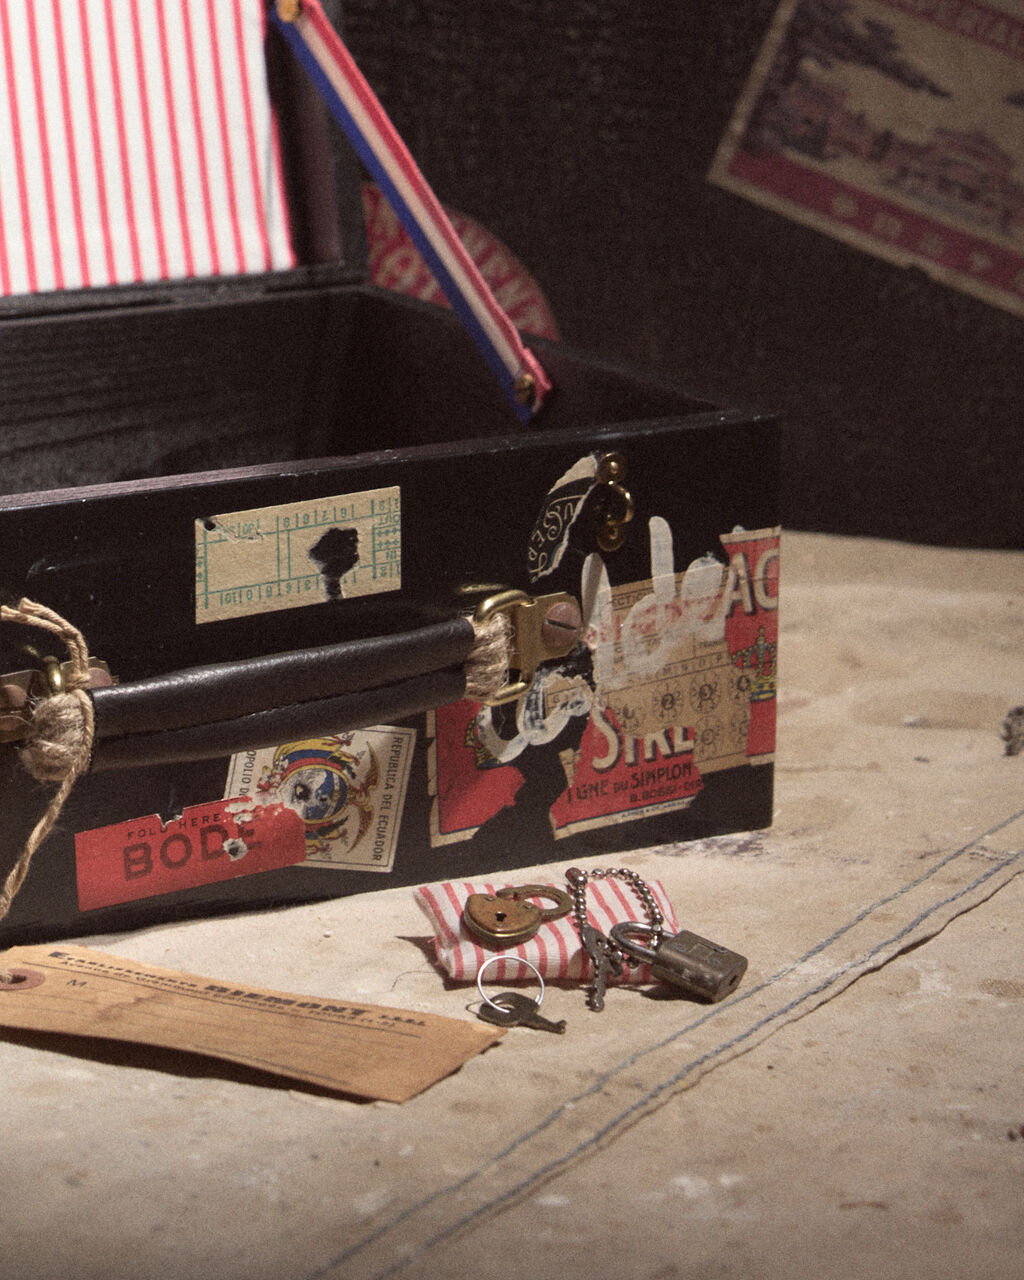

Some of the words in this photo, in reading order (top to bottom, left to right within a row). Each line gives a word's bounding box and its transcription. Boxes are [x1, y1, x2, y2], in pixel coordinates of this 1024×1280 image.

[384, 736, 404, 791] REPUBLICA
[631, 761, 693, 790] SIMPLON
[380, 794, 393, 812] DEL
[178, 813, 221, 830] HERE
[371, 814, 388, 862] ECUADOR
